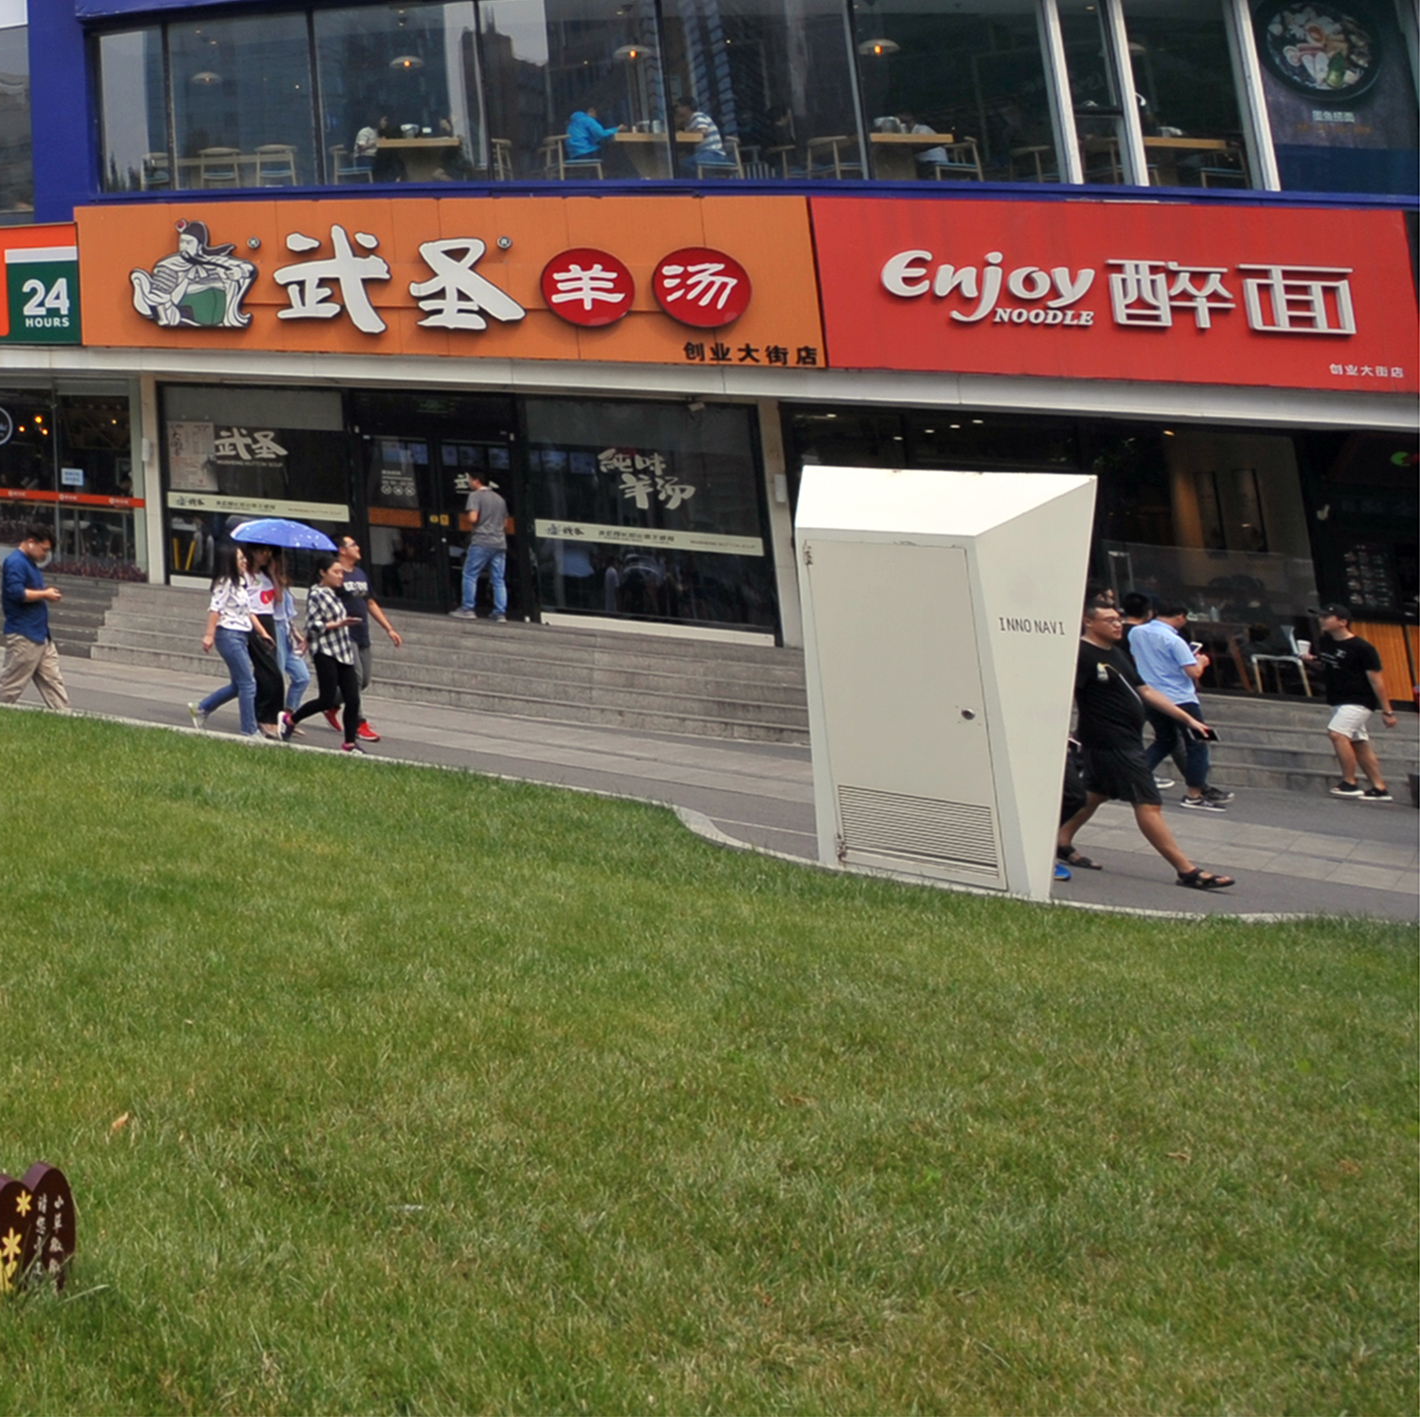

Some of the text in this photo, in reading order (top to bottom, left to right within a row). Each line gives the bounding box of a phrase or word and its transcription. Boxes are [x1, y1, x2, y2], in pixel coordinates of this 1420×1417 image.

[21, 277, 71, 316] 24
[273, 224, 527, 335] 武圣
[550, 261, 740, 312] 羊汤
[880, 249, 1096, 324] Enjoy
[1104, 257, 1358, 335] 醉面
[24, 317, 71, 328] HOURS
[993, 306, 1095, 327] NOODLE
[682, 339, 820, 367] 创业大街店
[1329, 363, 1406, 379] 创业大街店
[214, 427, 289, 461] 武圣
[998, 616, 1066, 636] INNO NAVI
